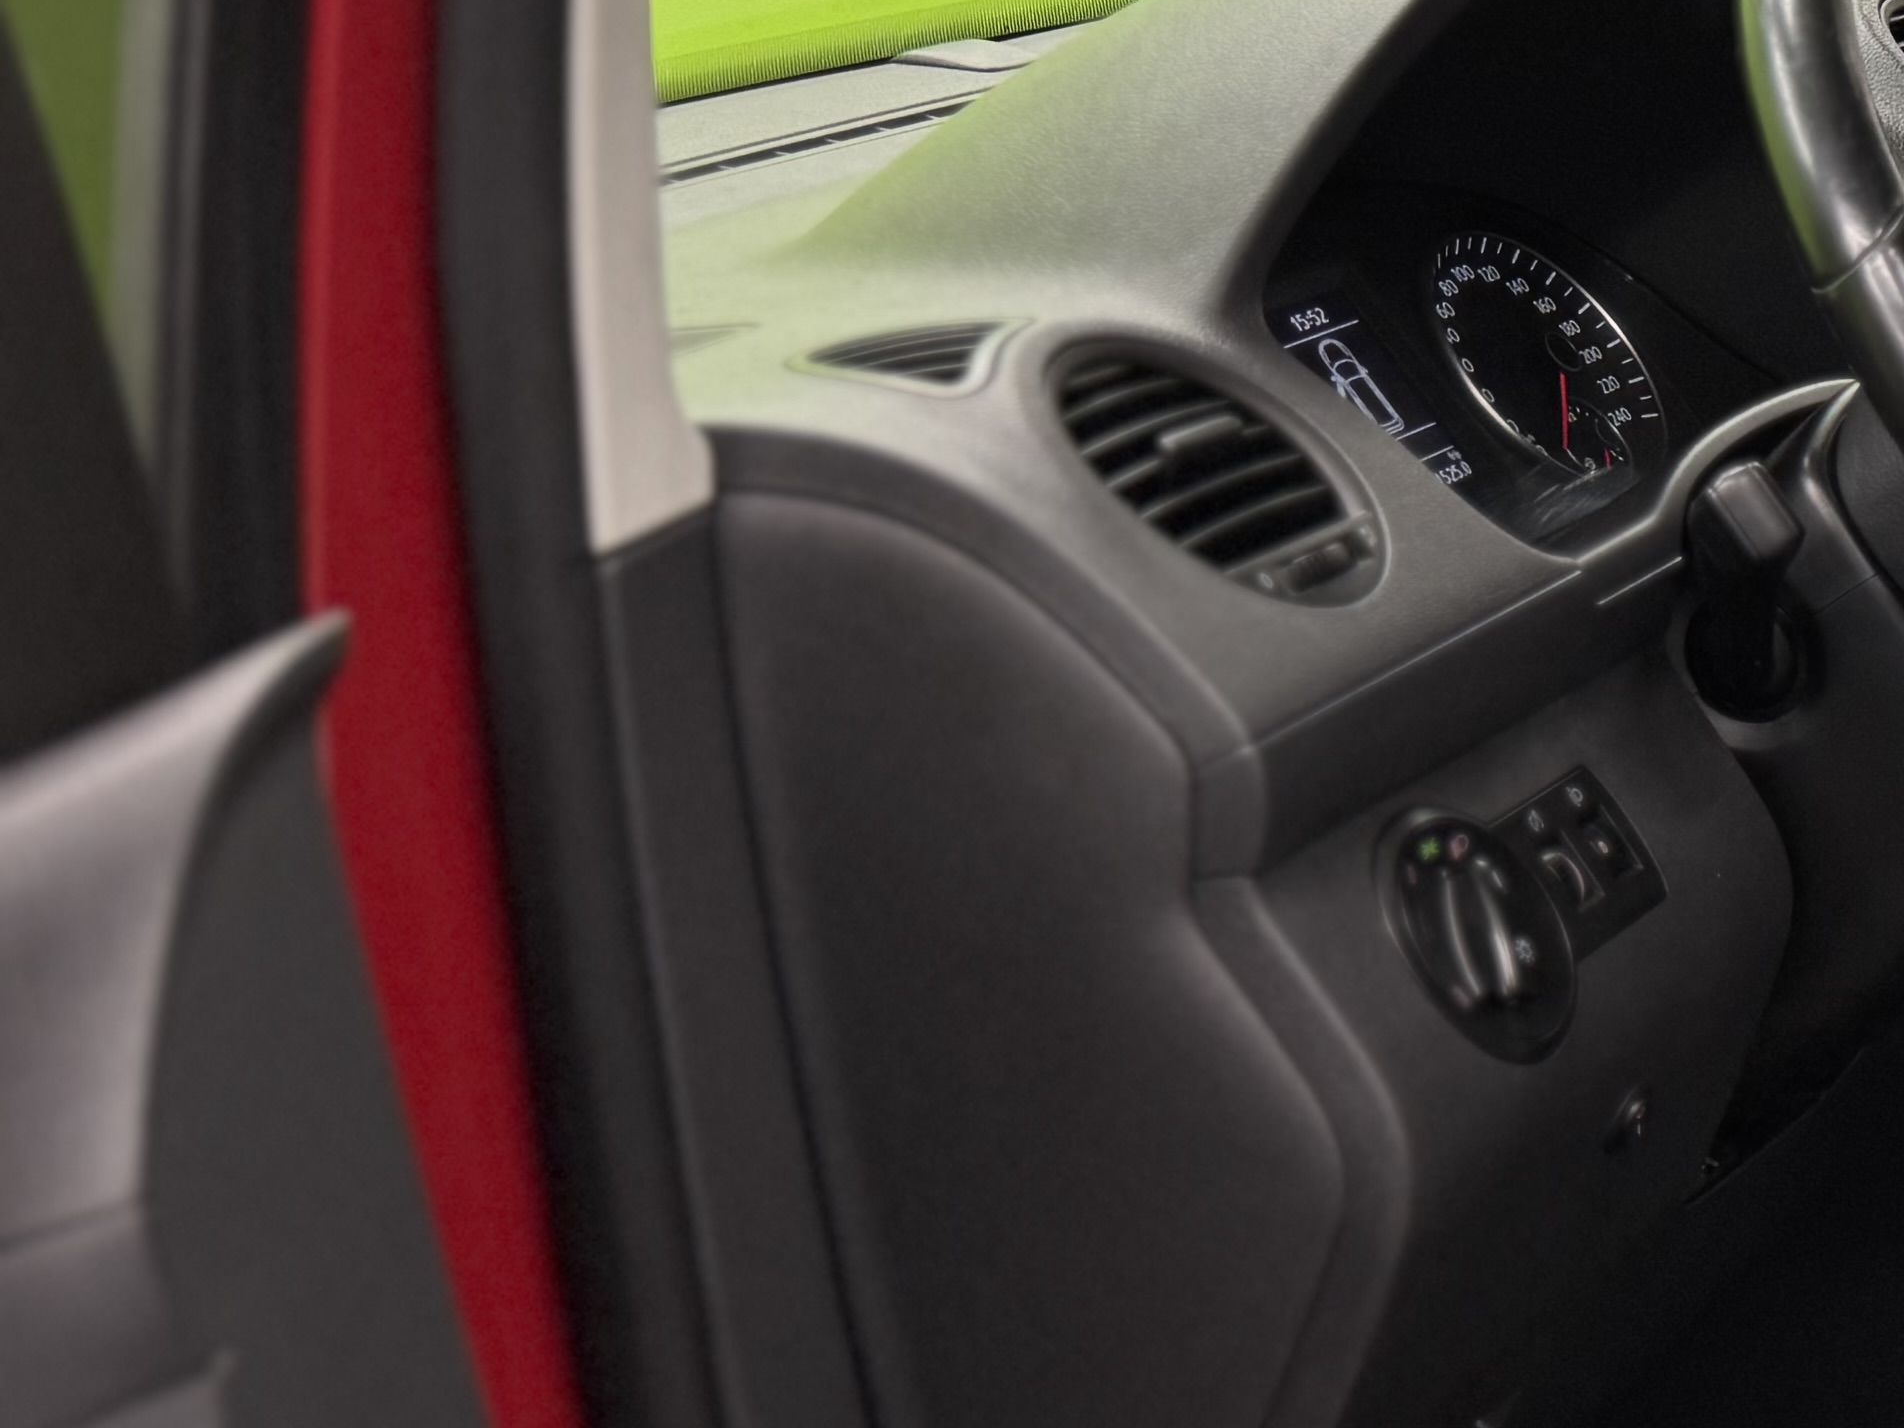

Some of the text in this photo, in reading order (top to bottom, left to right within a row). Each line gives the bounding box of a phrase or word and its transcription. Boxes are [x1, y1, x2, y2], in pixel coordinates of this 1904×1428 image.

[1450, 264, 1475, 283] 100
[1478, 265, 1501, 283] 120
[1438, 279, 1459, 297] 80
[1506, 277, 1530, 296] 140
[1435, 301, 1456, 320] 60
[1533, 296, 1557, 315] 160
[1290, 307, 1330, 332] 15:52
[1559, 319, 1581, 338] 180
[1579, 346, 1603, 365] 200
[1597, 375, 1621, 395] 220
[1608, 407, 1632, 427] 240
